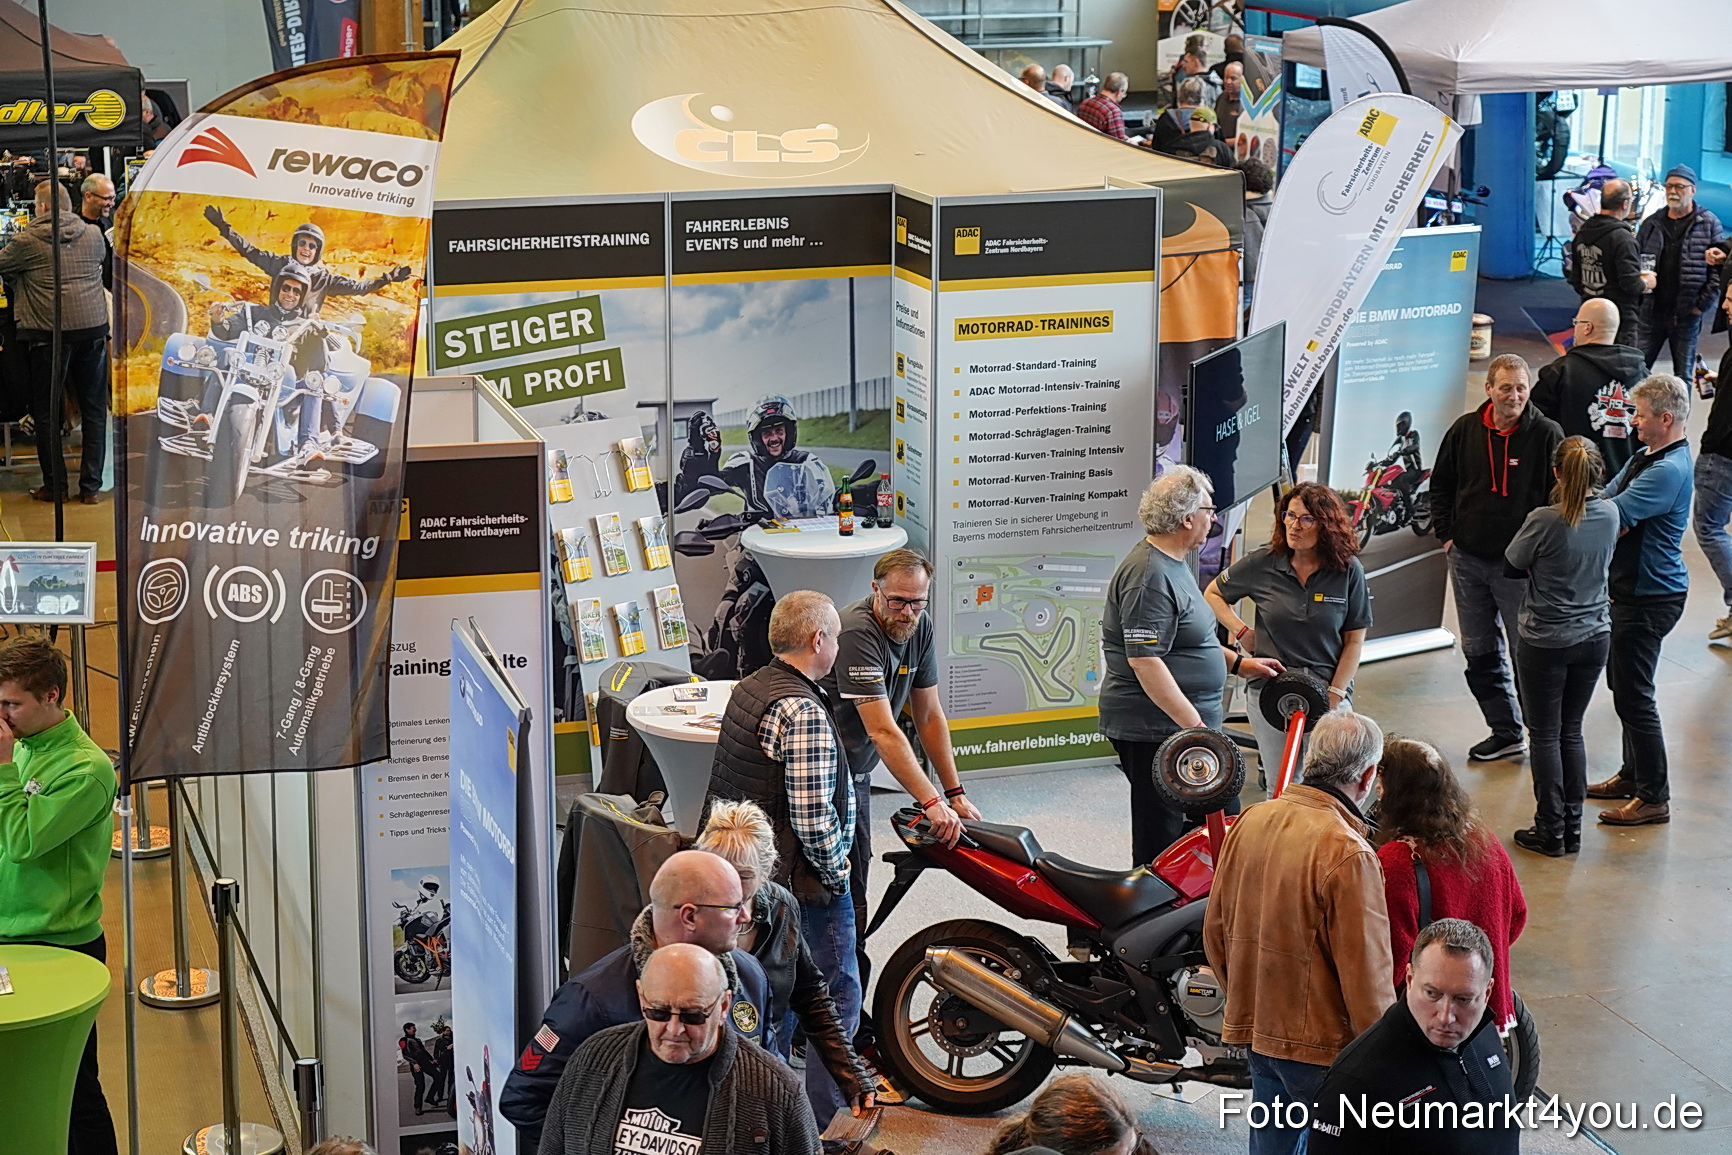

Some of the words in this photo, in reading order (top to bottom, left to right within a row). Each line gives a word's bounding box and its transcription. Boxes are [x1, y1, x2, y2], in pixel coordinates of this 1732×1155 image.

[1358, 108, 1380, 137] ADAC
[674, 128, 840, 163] CLS
[266, 145, 424, 188] rewaco
[1340, 143, 1374, 197] Fahrsicherheits-
[1361, 146, 1382, 176] Zentrum
[1366, 150, 1391, 192] NORDBAYERN
[308, 182, 374, 200] Innovative
[376, 189, 415, 208] triking
[685, 216, 789, 233] FAHRERLEBNIS
[956, 228, 979, 239] ADAC
[448, 233, 650, 253] FAHRSICHERHEITSTRAINING
[685, 237, 739, 252] EVENTS
[743, 235, 769, 250] und
[771, 234, 805, 249] mehr
[985, 239, 1001, 247] ADAC
[1283, 353, 1310, 403] SWELT
[1314, 244, 1374, 339] NORDBAYERN
[1368, 215, 1389, 243] MIT
[1384, 130, 1435, 215] SICHERHEIT
[895, 300, 910, 317] Preise
[1368, 309, 1399, 323] BMW
[1400, 303, 1462, 320] MOTORRAD
[444, 308, 594, 359] STEIGER
[957, 315, 1110, 336] MOTORRAD-TRAININGS
[970, 358, 1097, 375] Motorrad-Standard-Training
[524, 359, 611, 396] PROFI
[969, 386, 996, 397] ADAC
[998, 378, 1121, 395] Motorrad-Intensiv-Training
[969, 402, 1107, 420] Motorrad-Perfektions-Training
[968, 424, 1111, 442] Motorrad-Schräglagen-Training
[1215, 415, 1237, 443] HASE
[1237, 412, 1243, 430] &
[1244, 403, 1261, 427] IGEL
[968, 447, 1086, 465] Motorrad-Kurven-Training
[1088, 445, 1124, 455] Intensiv
[968, 470, 1086, 487] Motorrad-Kurven-Training
[1088, 467, 1113, 478] Basis
[968, 491, 1085, 509] Motorrad-Kurven-Training
[1087, 488, 1128, 501] Kompakt
[420, 517, 447, 529] ADAC
[449, 514, 529, 528] Fahrsicherheits-
[952, 518, 992, 529] Trainieren
[994, 517, 1008, 527] Sie
[1010, 516, 1019, 525] in
[1020, 514, 1053, 524] sicherer
[1055, 510, 1099, 523] Umgebung
[1101, 510, 1109, 518] in
[140, 516, 279, 548] Innovative
[289, 526, 379, 560] triking
[420, 529, 461, 540] Zentrum
[463, 526, 520, 539] Nordbayern
[952, 532, 986, 544] Bayerns
[987, 528, 1040, 540] modernstem
[228, 584, 263, 604] ABS
[191, 639, 240, 755] Antiblockiersystem
[275, 697, 302, 740] 7-Gang
[295, 645, 321, 689] 8-Gang
[289, 647, 336, 757] Automatikgetriebe
[424, 717, 450, 726] Lenken
[433, 735, 447, 743] des
[387, 756, 420, 766] Richtiges
[387, 775, 420, 783] Bremsen
[430, 773, 443, 781] der
[388, 789, 448, 801] Kurventechniken
[389, 828, 409, 838] Tipps
[411, 827, 424, 836] und
[426, 825, 447, 835] Tricks
[630, 1111, 671, 1133] MOTOR
